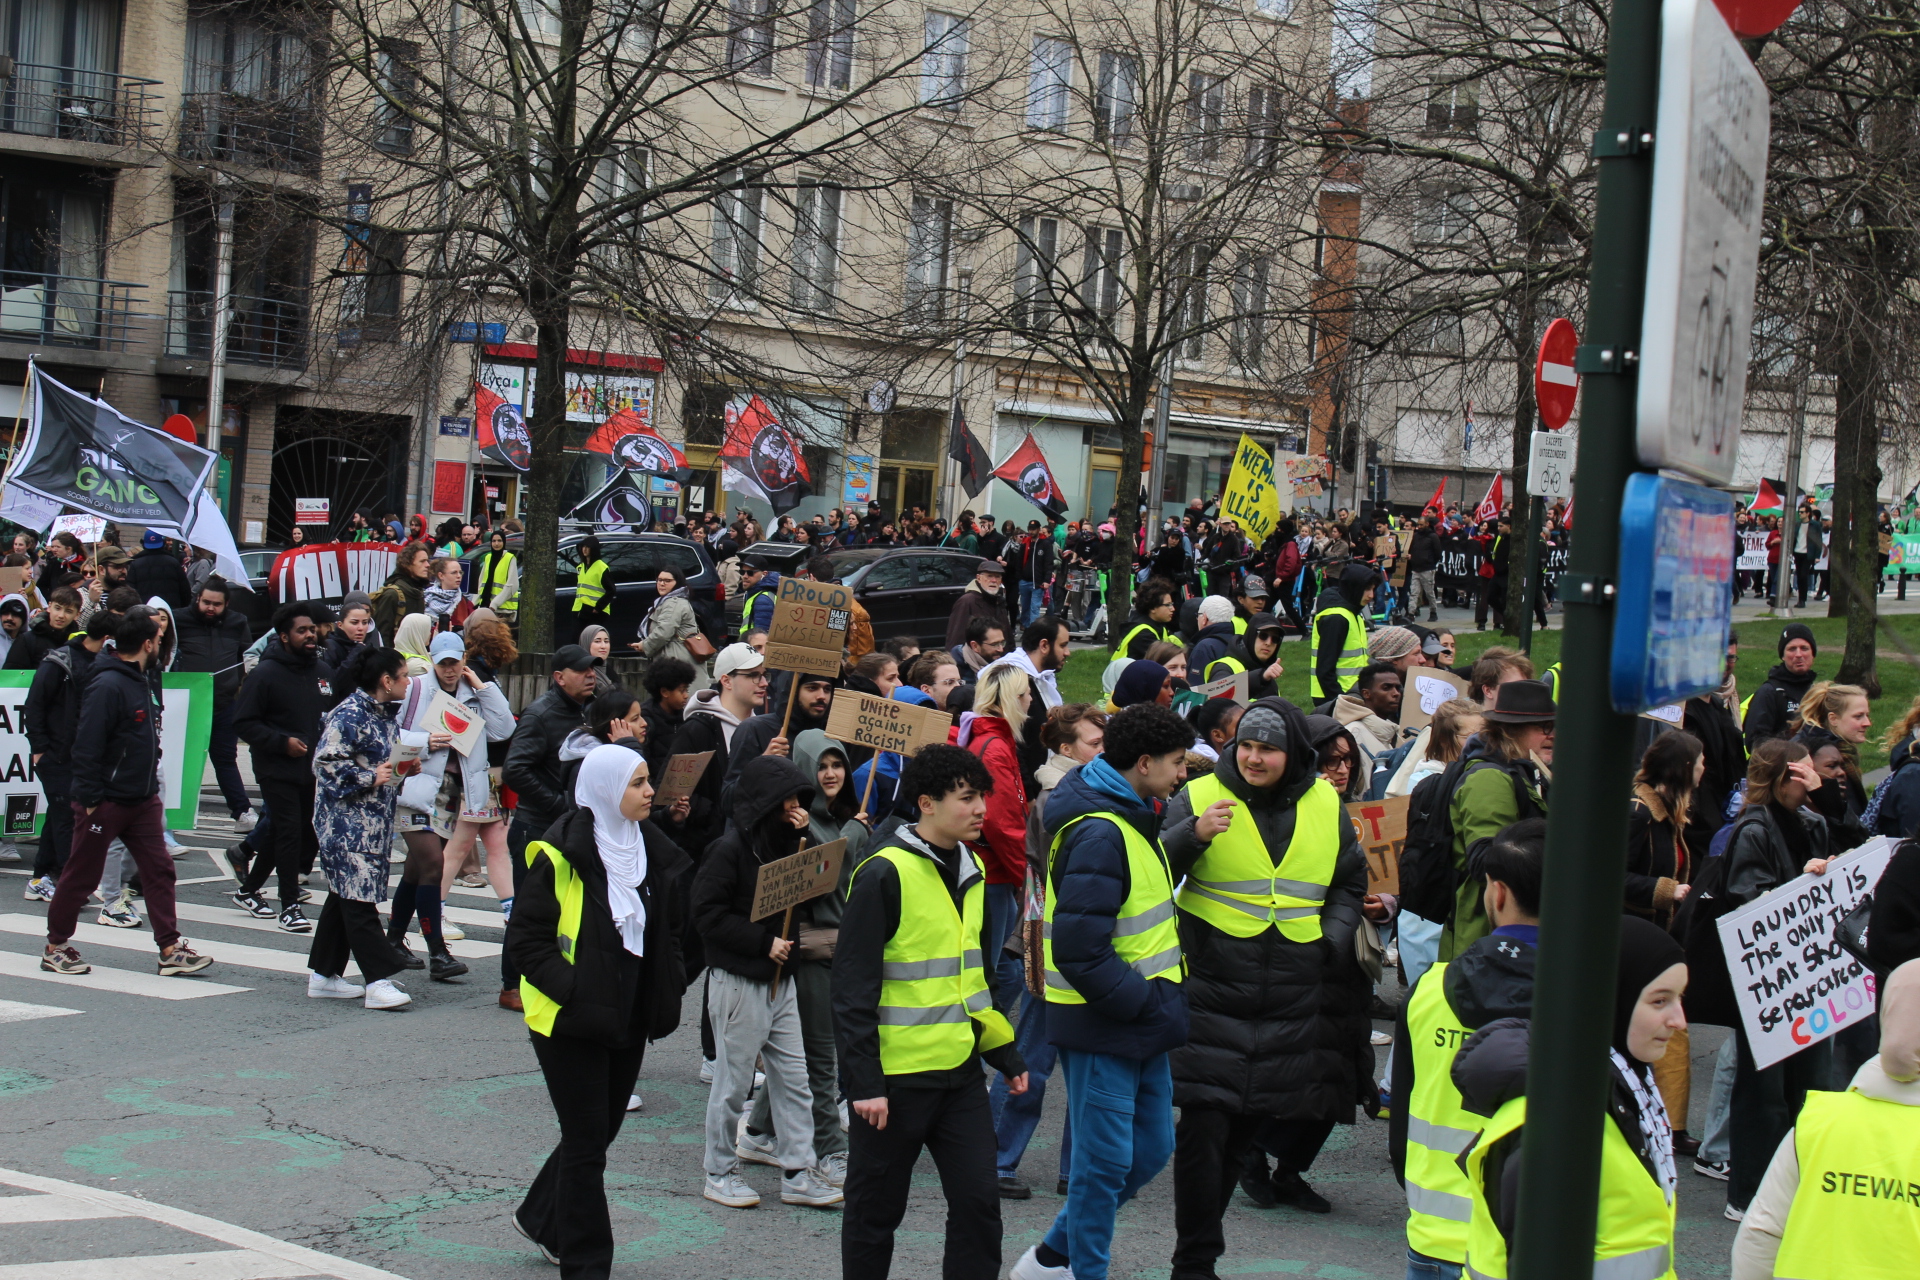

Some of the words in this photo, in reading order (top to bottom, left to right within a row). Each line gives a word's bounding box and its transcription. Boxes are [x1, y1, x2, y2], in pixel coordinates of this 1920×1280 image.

[75, 466, 161, 505] GANG
[437, 483, 460, 495] GOD
[1247, 479, 1264, 503] IS
[66, 490, 94, 505] SCOREN
[94, 499, 104, 508] OP
[104, 501, 114, 511] EN
[1741, 555, 1766, 566] CONTRE
[781, 580, 846, 607] PROUD
[813, 608, 827, 625] B
[830, 609, 849, 620] HAAT
[773, 623, 840, 644] MYSELF
[1418, 677, 1436, 694] WE
[670, 760, 696, 773] LOVE
[15, 812, 31, 820] DIEP
[12, 821, 33, 829] GANG
[762, 878, 780, 894] VAN
[1737, 878, 1834, 950] LAUNDRY
[1741, 941, 1783, 976] The
[1821, 1170, 1920, 1208] STEWAR
